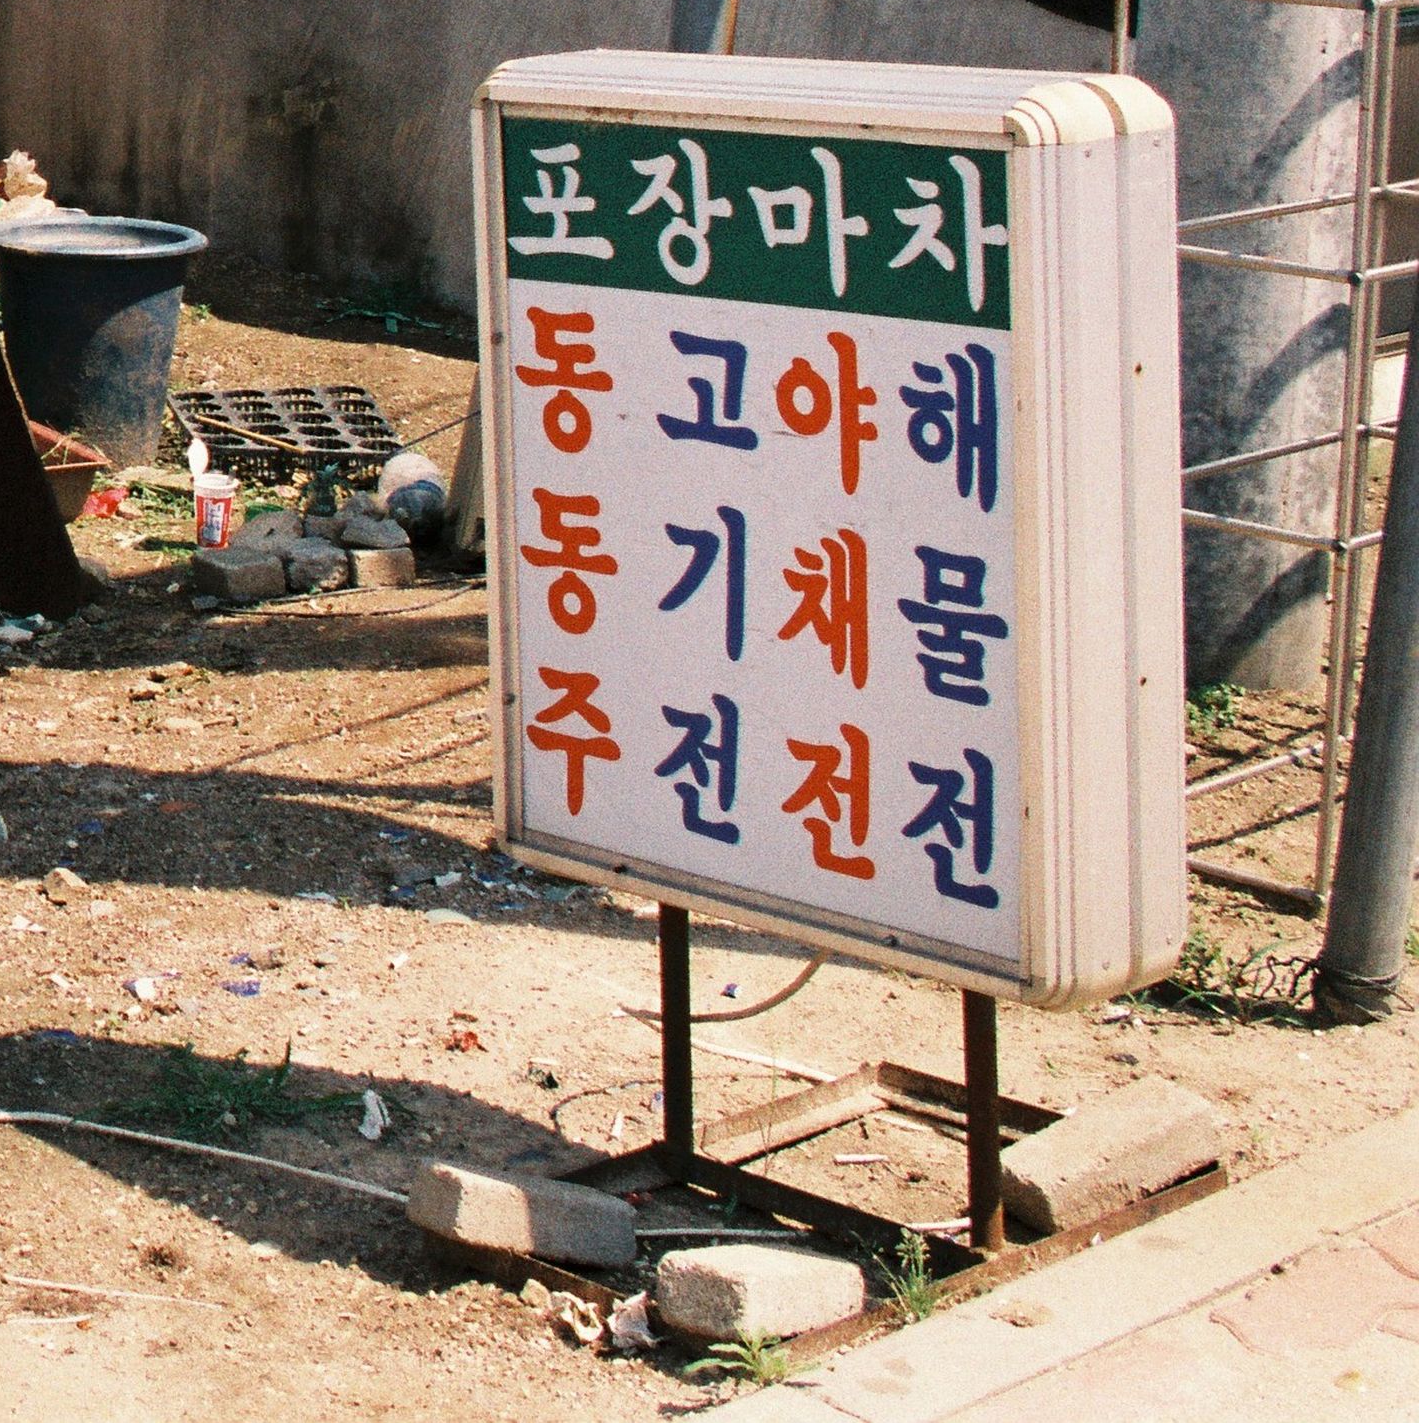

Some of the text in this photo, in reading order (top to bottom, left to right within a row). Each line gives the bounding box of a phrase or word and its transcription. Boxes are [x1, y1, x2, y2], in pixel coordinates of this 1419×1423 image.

[508, 139, 1009, 313] 포장마차
[515, 306, 622, 816] 동동주
[656, 330, 759, 844] 고기전
[775, 332, 879, 881] 야채전
[899, 344, 1009, 908] 해물전
